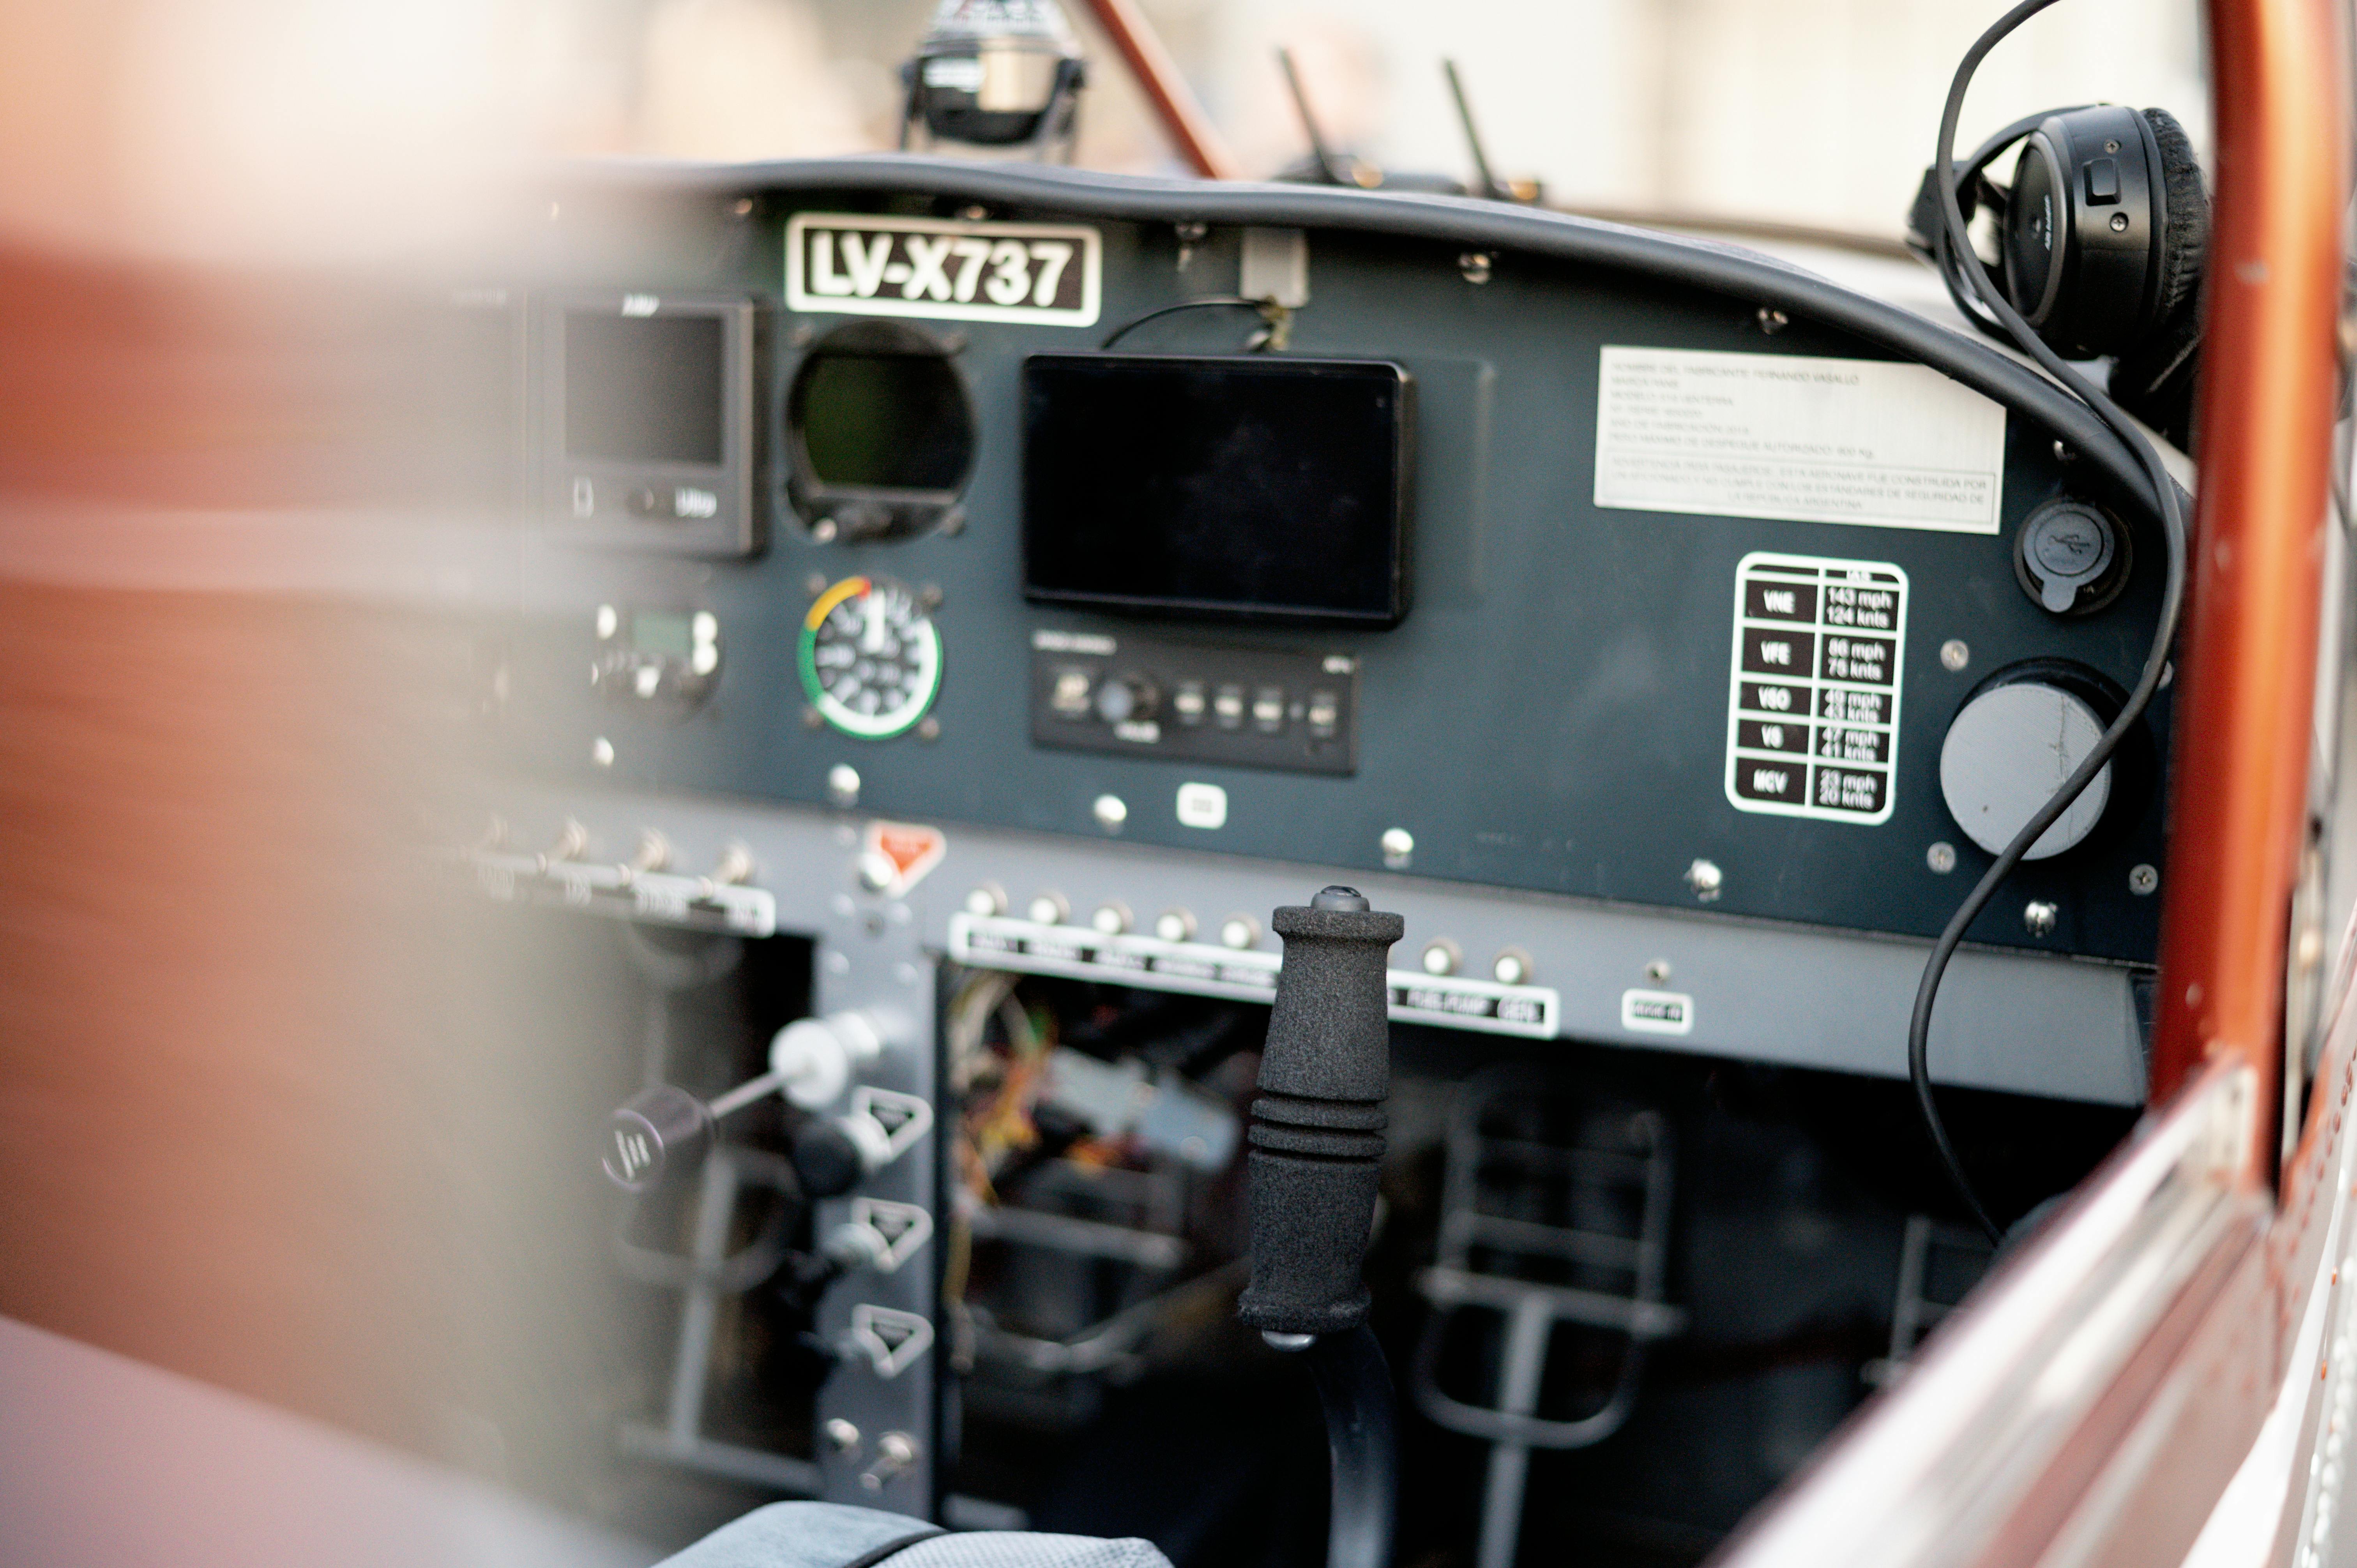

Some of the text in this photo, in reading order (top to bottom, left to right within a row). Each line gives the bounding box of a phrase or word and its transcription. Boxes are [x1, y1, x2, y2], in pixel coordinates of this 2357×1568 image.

[810, 232, 1073, 307] LV-X737
[1763, 590, 1795, 614] VNE
[1828, 587, 1893, 610] 143 mph
[1827, 604, 1855, 625] 124
[1760, 641, 1792, 665] VFE
[1851, 642, 1886, 662] mph
[1848, 692, 1883, 710] mph
[1845, 729, 1880, 748] mph
[1843, 773, 1878, 794] mph
